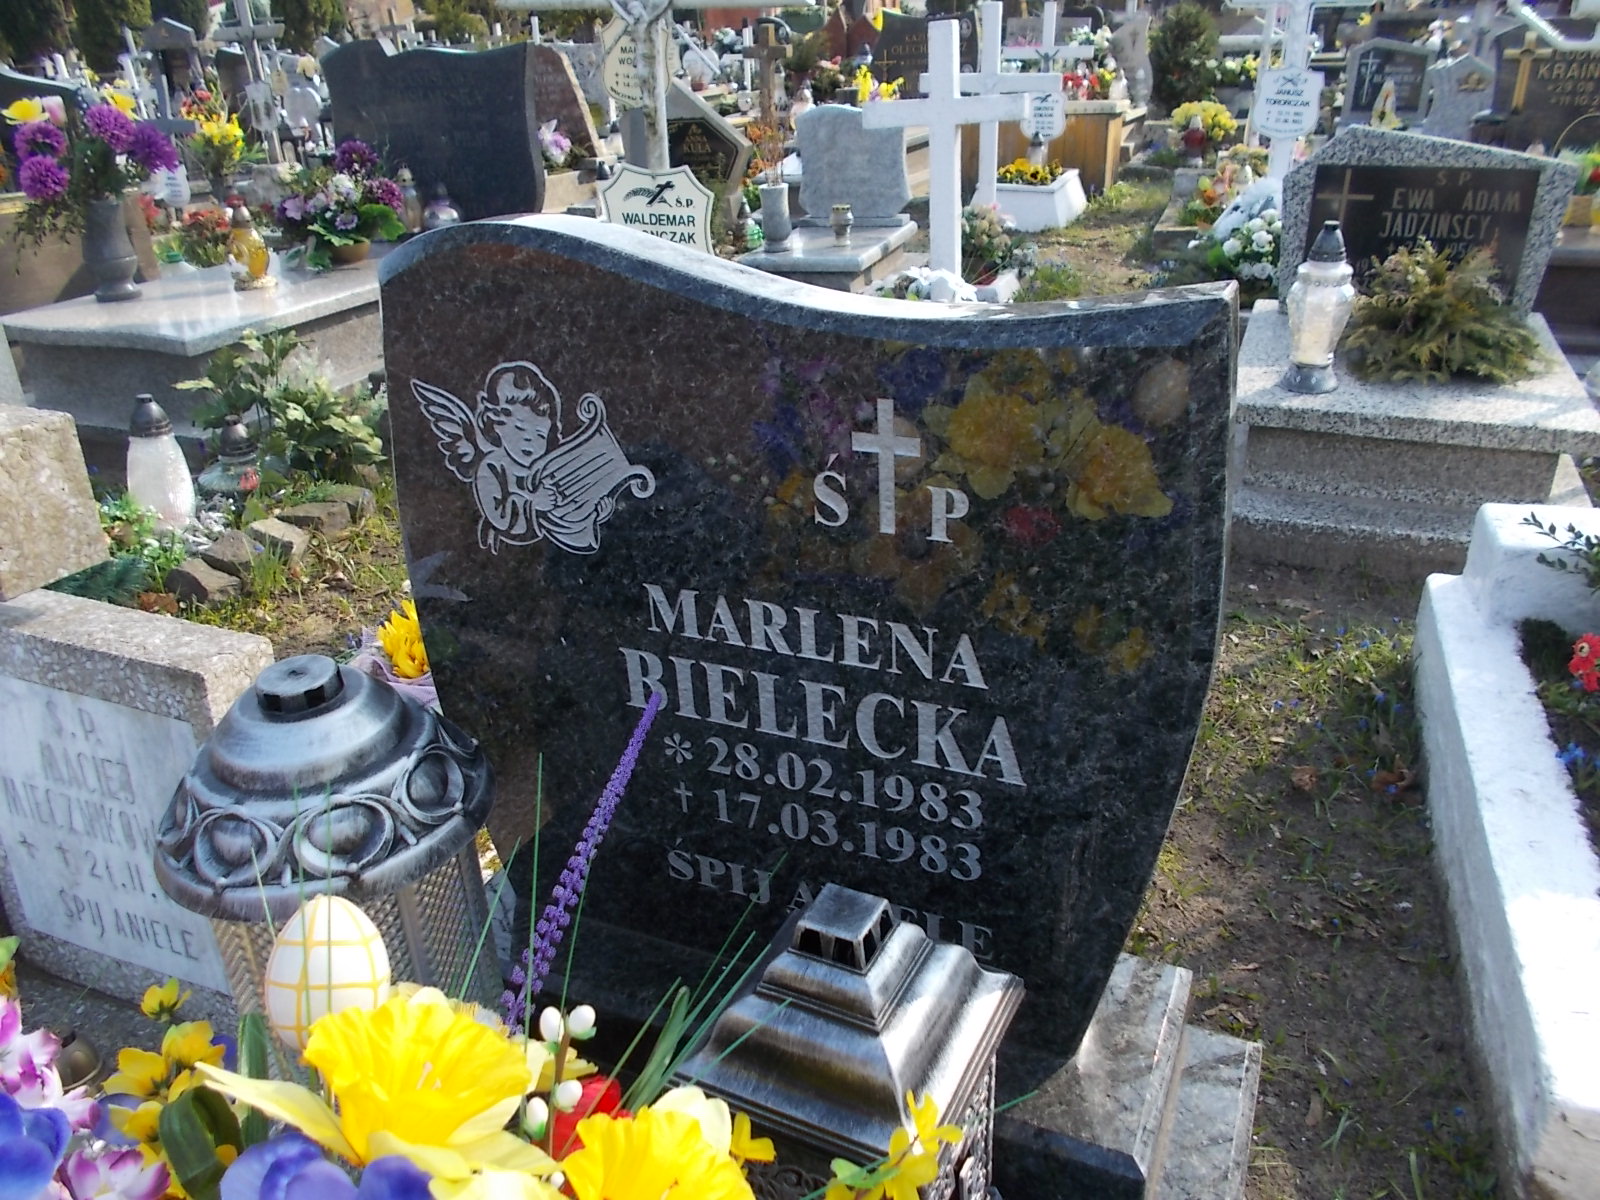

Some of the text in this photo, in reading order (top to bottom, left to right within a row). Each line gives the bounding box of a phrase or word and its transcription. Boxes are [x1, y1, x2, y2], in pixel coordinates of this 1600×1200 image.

[622, 212, 696, 227] WALDEMAR
[1391, 188, 1521, 213] EWA ADAM
[813, 452, 971, 544] Ś P
[642, 582, 990, 691] MARLENA
[617, 646, 1028, 788] BIELECKA
[704, 736, 985, 831] 28.02.1983
[666, 837, 772, 904] ŚPIJ
[711, 787, 984, 882] 17.03.1983
[113, 907, 200, 961] ANIELE
